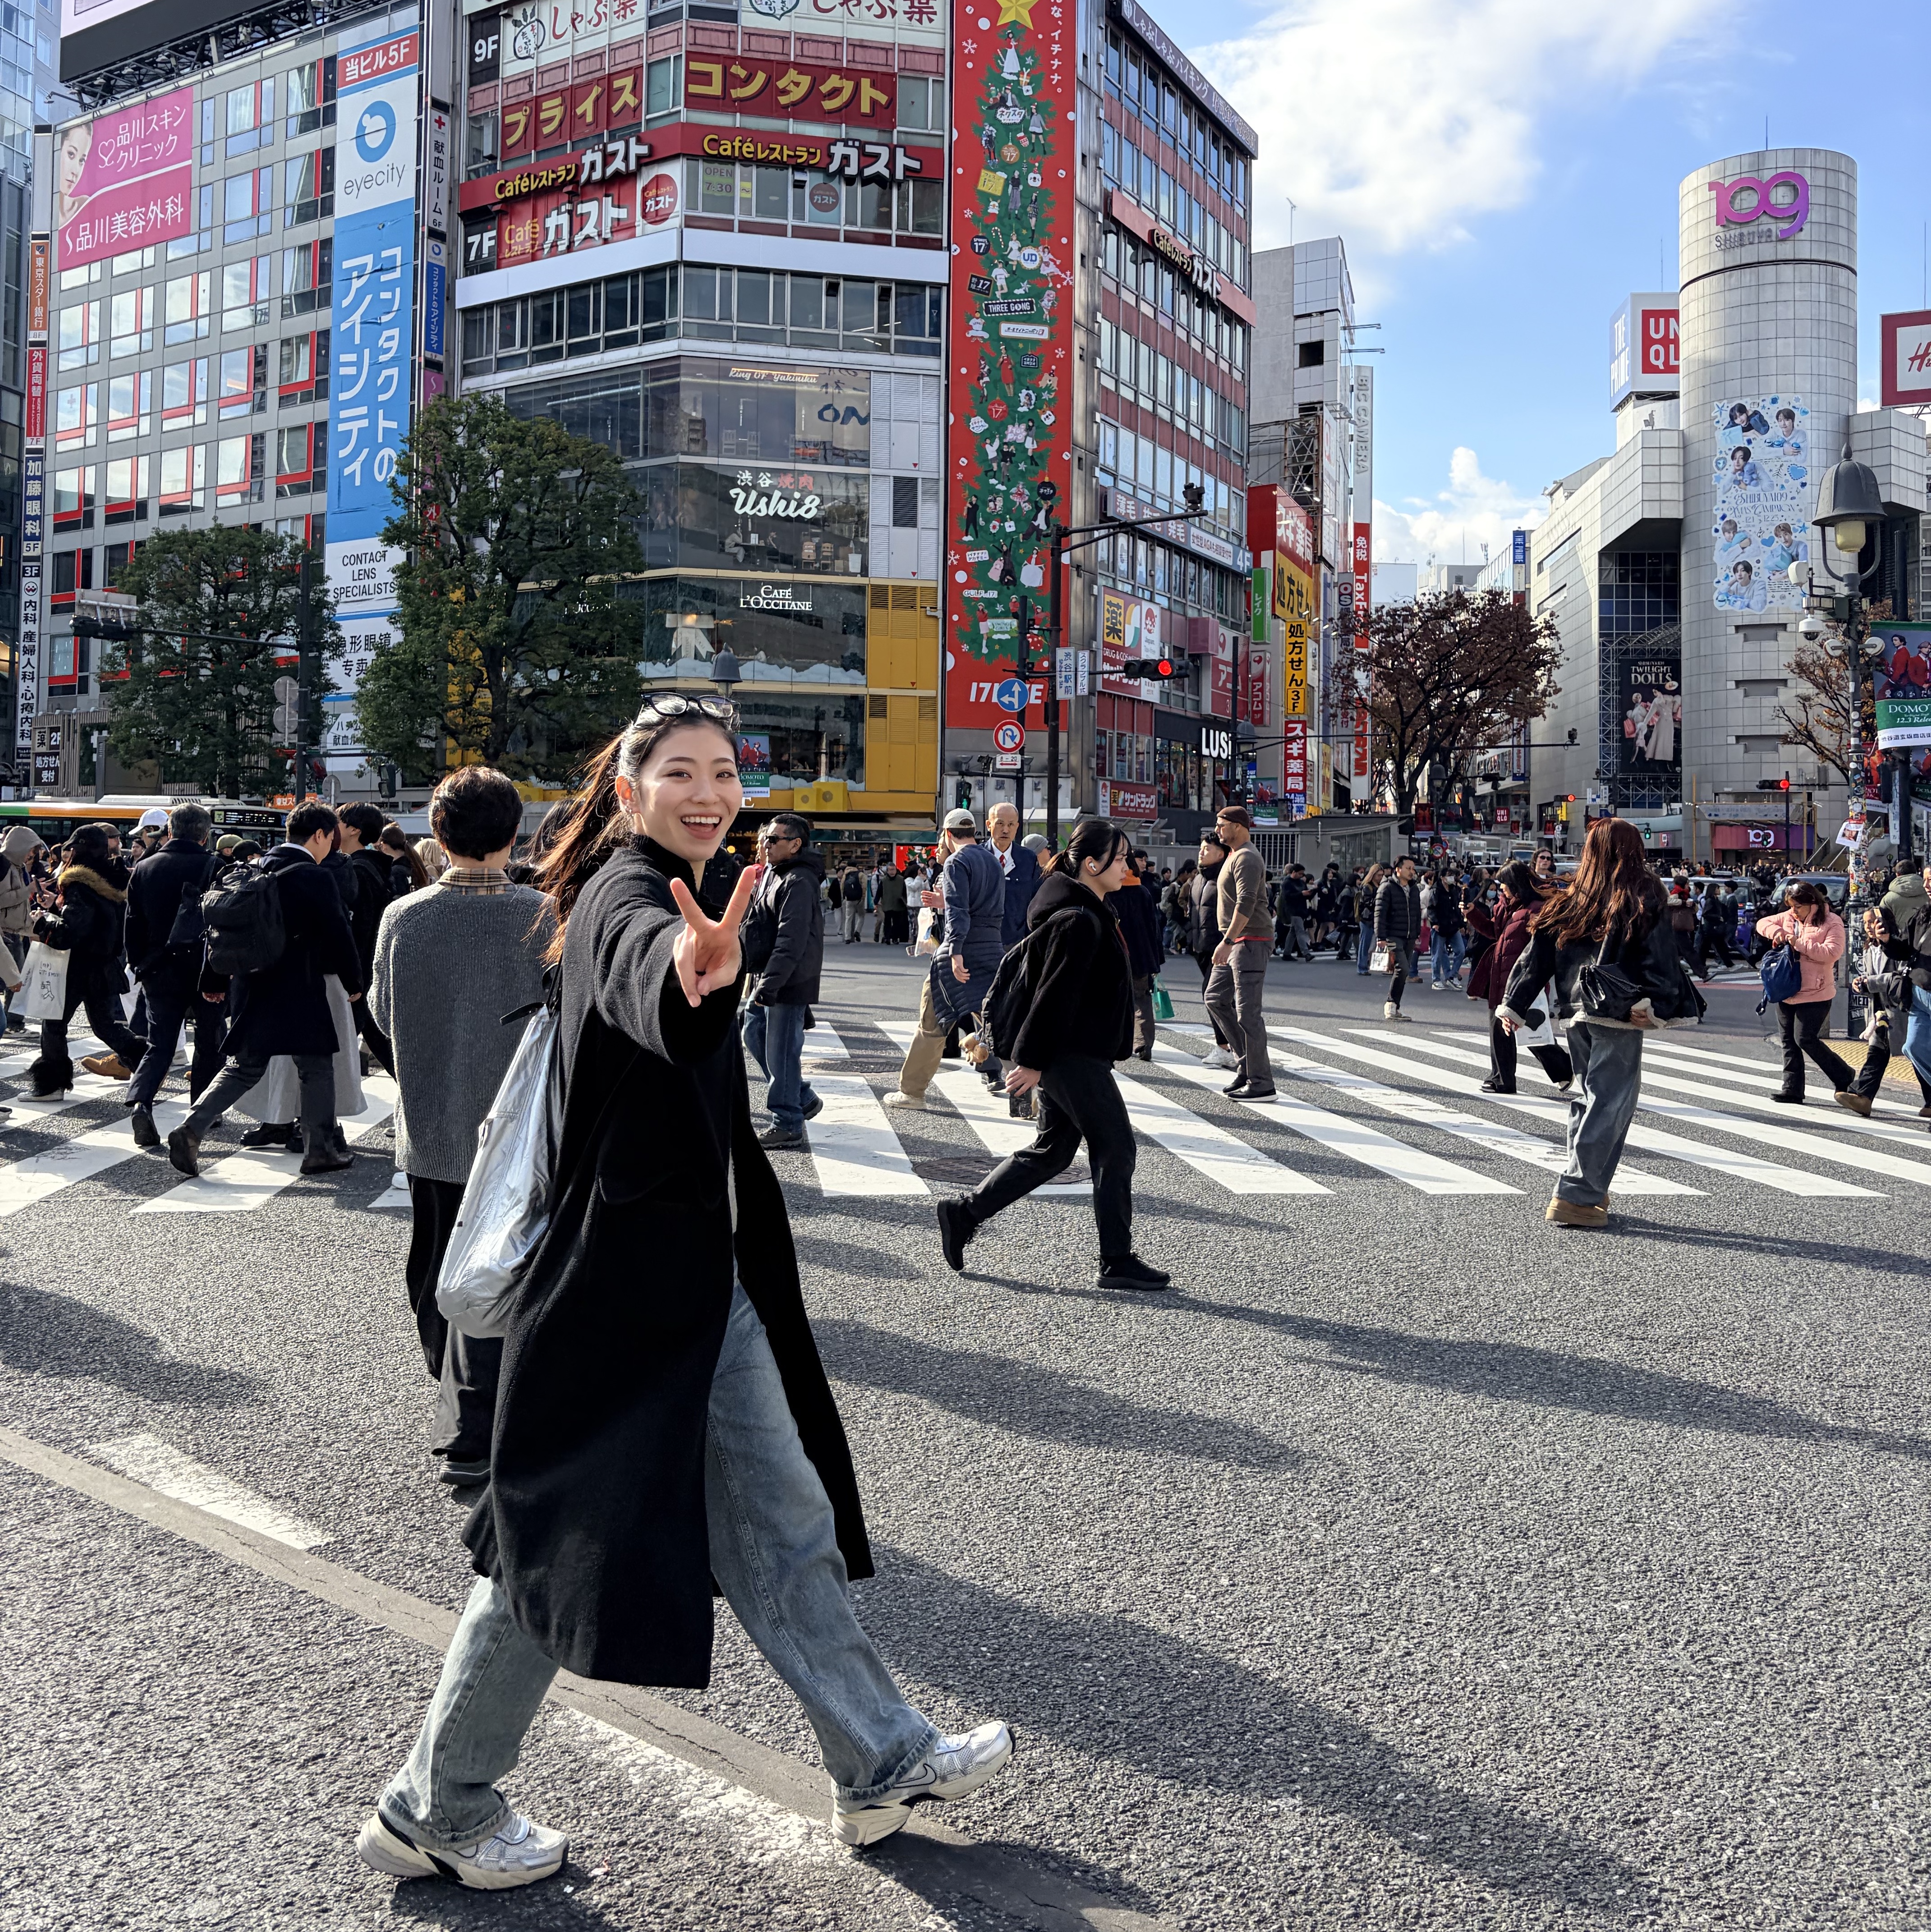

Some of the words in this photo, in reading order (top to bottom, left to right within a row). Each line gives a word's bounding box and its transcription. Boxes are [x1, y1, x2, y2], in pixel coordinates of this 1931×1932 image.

[344, 39, 410, 82] 当ビル5F
[474, 34, 499, 62] 9F
[1050, 0, 1063, 93] な、イチナナ。
[688, 61, 889, 115] コンタクト
[116, 105, 187, 144] 品川スキン
[505, 75, 638, 146] プライス
[116, 133, 179, 172] クリニック
[581, 137, 650, 185] ガスト
[829, 139, 922, 180] ガスト
[1006, 153, 1018, 161] 17
[343, 163, 406, 199] eyecity
[432, 139, 445, 215] 献血ルーム
[705, 167, 733, 177] OPEN
[705, 182, 732, 193] 7:30
[813, 194, 836, 204] ガスト
[645, 195, 674, 212] ガスト
[1708, 171, 1809, 239] 109
[76, 194, 184, 252] 品川美容外科
[505, 218, 540, 245] Café
[544, 195, 628, 255] ガスト
[467, 234, 496, 261] 7F
[974, 242, 986, 252] 17
[1023, 253, 1037, 262] UD
[977, 280, 991, 289] 17
[1192, 256, 1221, 298] ガスト
[34, 256, 45, 329] 東京スター銀行
[431, 267, 440, 349] コンタクトのアイシティ
[988, 304, 1009, 312] THREE
[1010, 302, 1030, 310] GONG
[1615, 313, 1626, 356] THE
[31, 349, 44, 398] 外貨両替
[337, 255, 374, 487] アイシティ
[373, 246, 403, 483] コンタクトの
[1610, 346, 1629, 397] PRIME
[1357, 375, 1368, 403] BIC
[992, 408, 1002, 418] 17
[29, 437, 41, 446] 7F
[1356, 408, 1368, 474] CAMERA
[737, 470, 772, 487] 渋谷
[778, 473, 813, 489] 焼肉
[25, 459, 42, 537] 加藤眼科
[729, 488, 821, 519] Ushi8
[25, 542, 40, 552] 5F
[1276, 503, 1312, 566] スギ薬局
[1356, 536, 1367, 561] 免税
[24, 567, 39, 577] 3F
[342, 550, 388, 567] CONTACT
[1237, 549, 1251, 573] 4F
[352, 567, 377, 581] LENS
[333, 582, 396, 599] SPECIALISTS
[1339, 583, 1353, 606] OS
[23, 599, 37, 626] 内科
[1106, 600, 1122, 641] 薬
[342, 657, 375, 677] 专卖
[1103, 647, 1116, 659] DRUG
[1288, 623, 1304, 687] 処方せん
[1064, 652, 1073, 695] 渋谷駅前
[1631, 673, 1672, 684] DOLLS
[1253, 682, 1262, 710] アコム
[1290, 690, 1301, 712] 3F
[37, 730, 46, 748] 薬
[1286, 723, 1304, 791] スギ薬局
[41, 770, 55, 782] 受付
[1124, 792, 1156, 809] サンドラッグ
